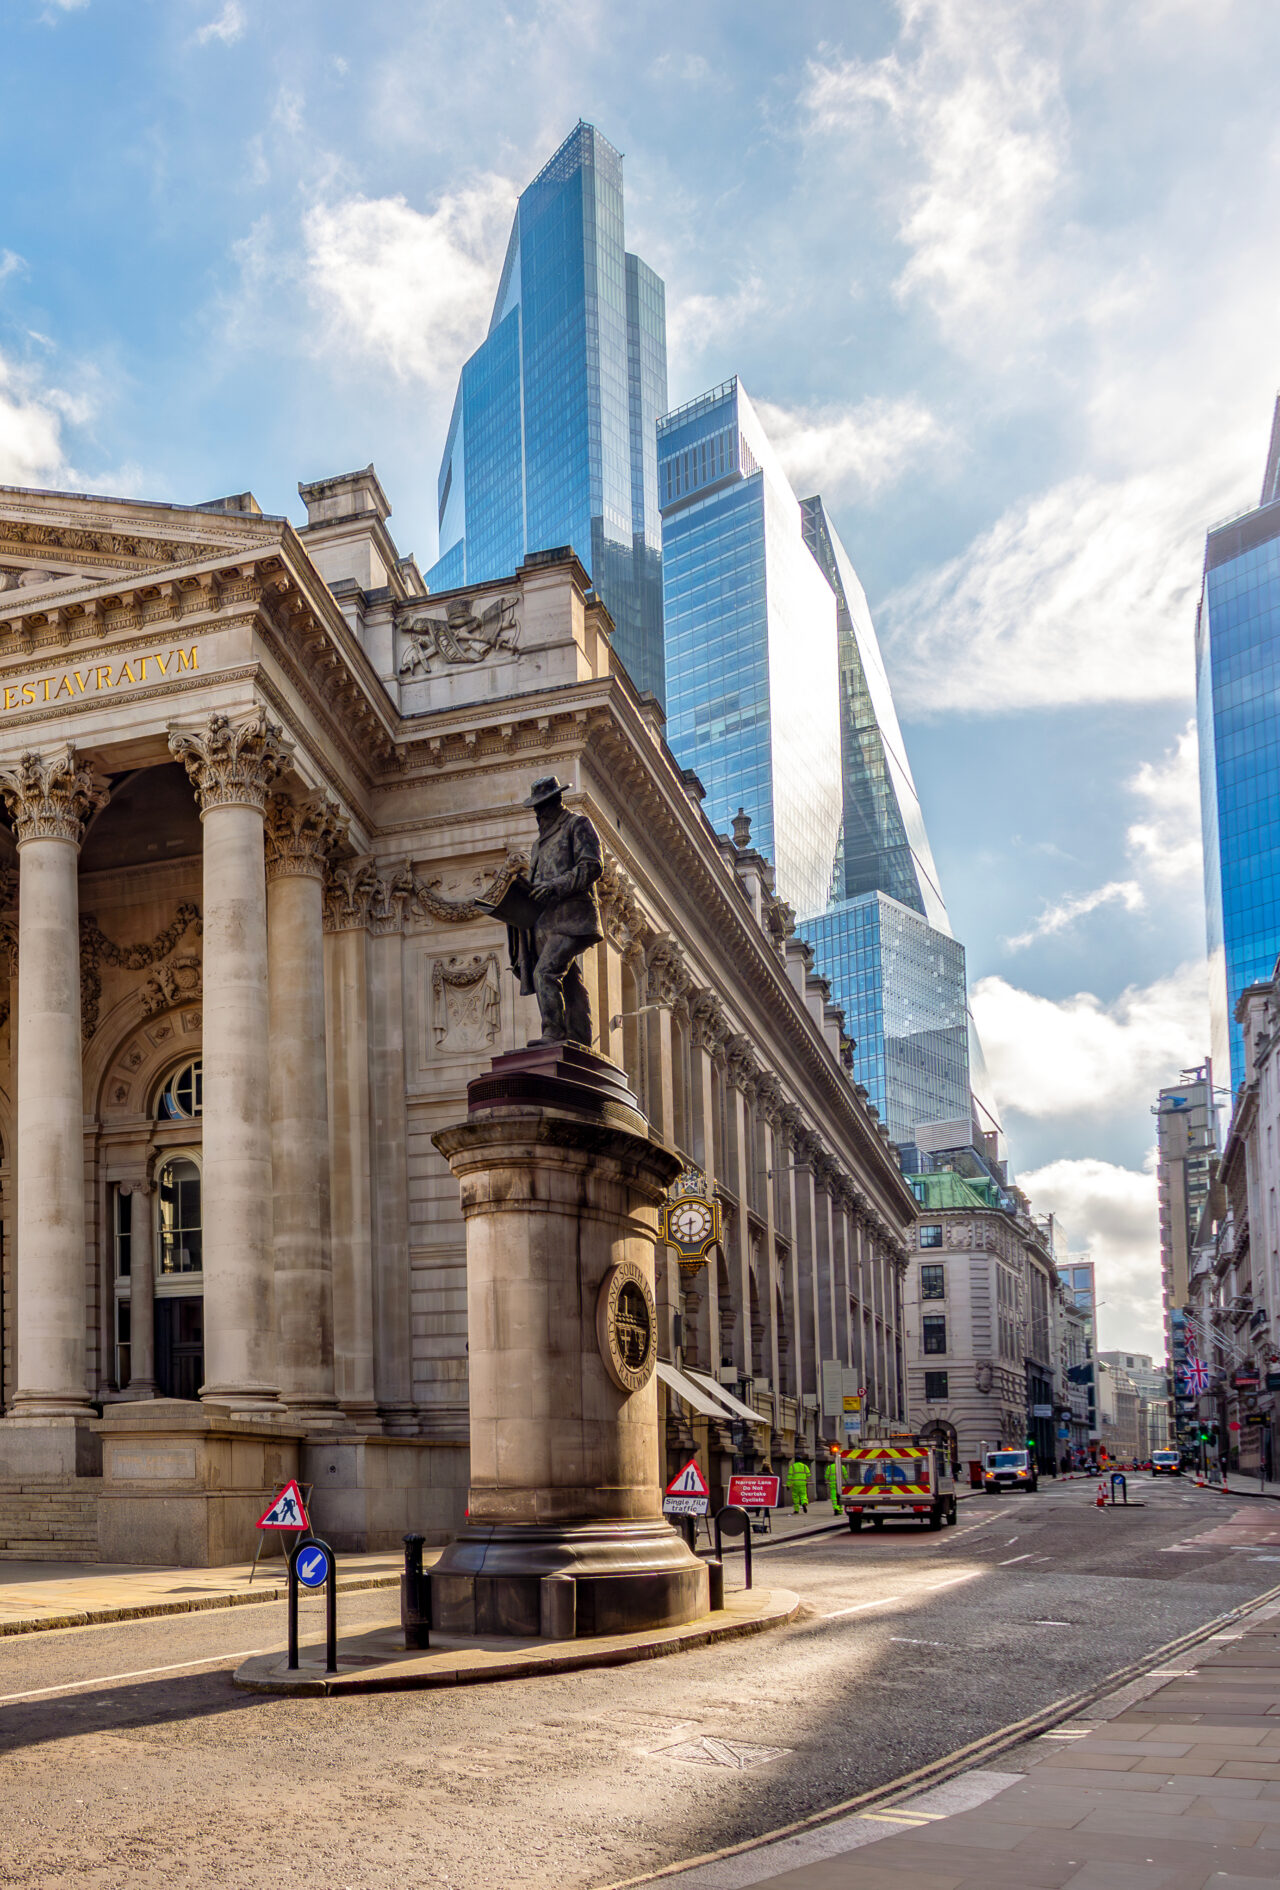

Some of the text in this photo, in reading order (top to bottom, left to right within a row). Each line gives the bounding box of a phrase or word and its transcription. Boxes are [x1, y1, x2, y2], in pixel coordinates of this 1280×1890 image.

[608, 1263, 657, 1390] CITY AND SOUTH LONDON RAILWAY
[665, 1498, 706, 1507] Single file
